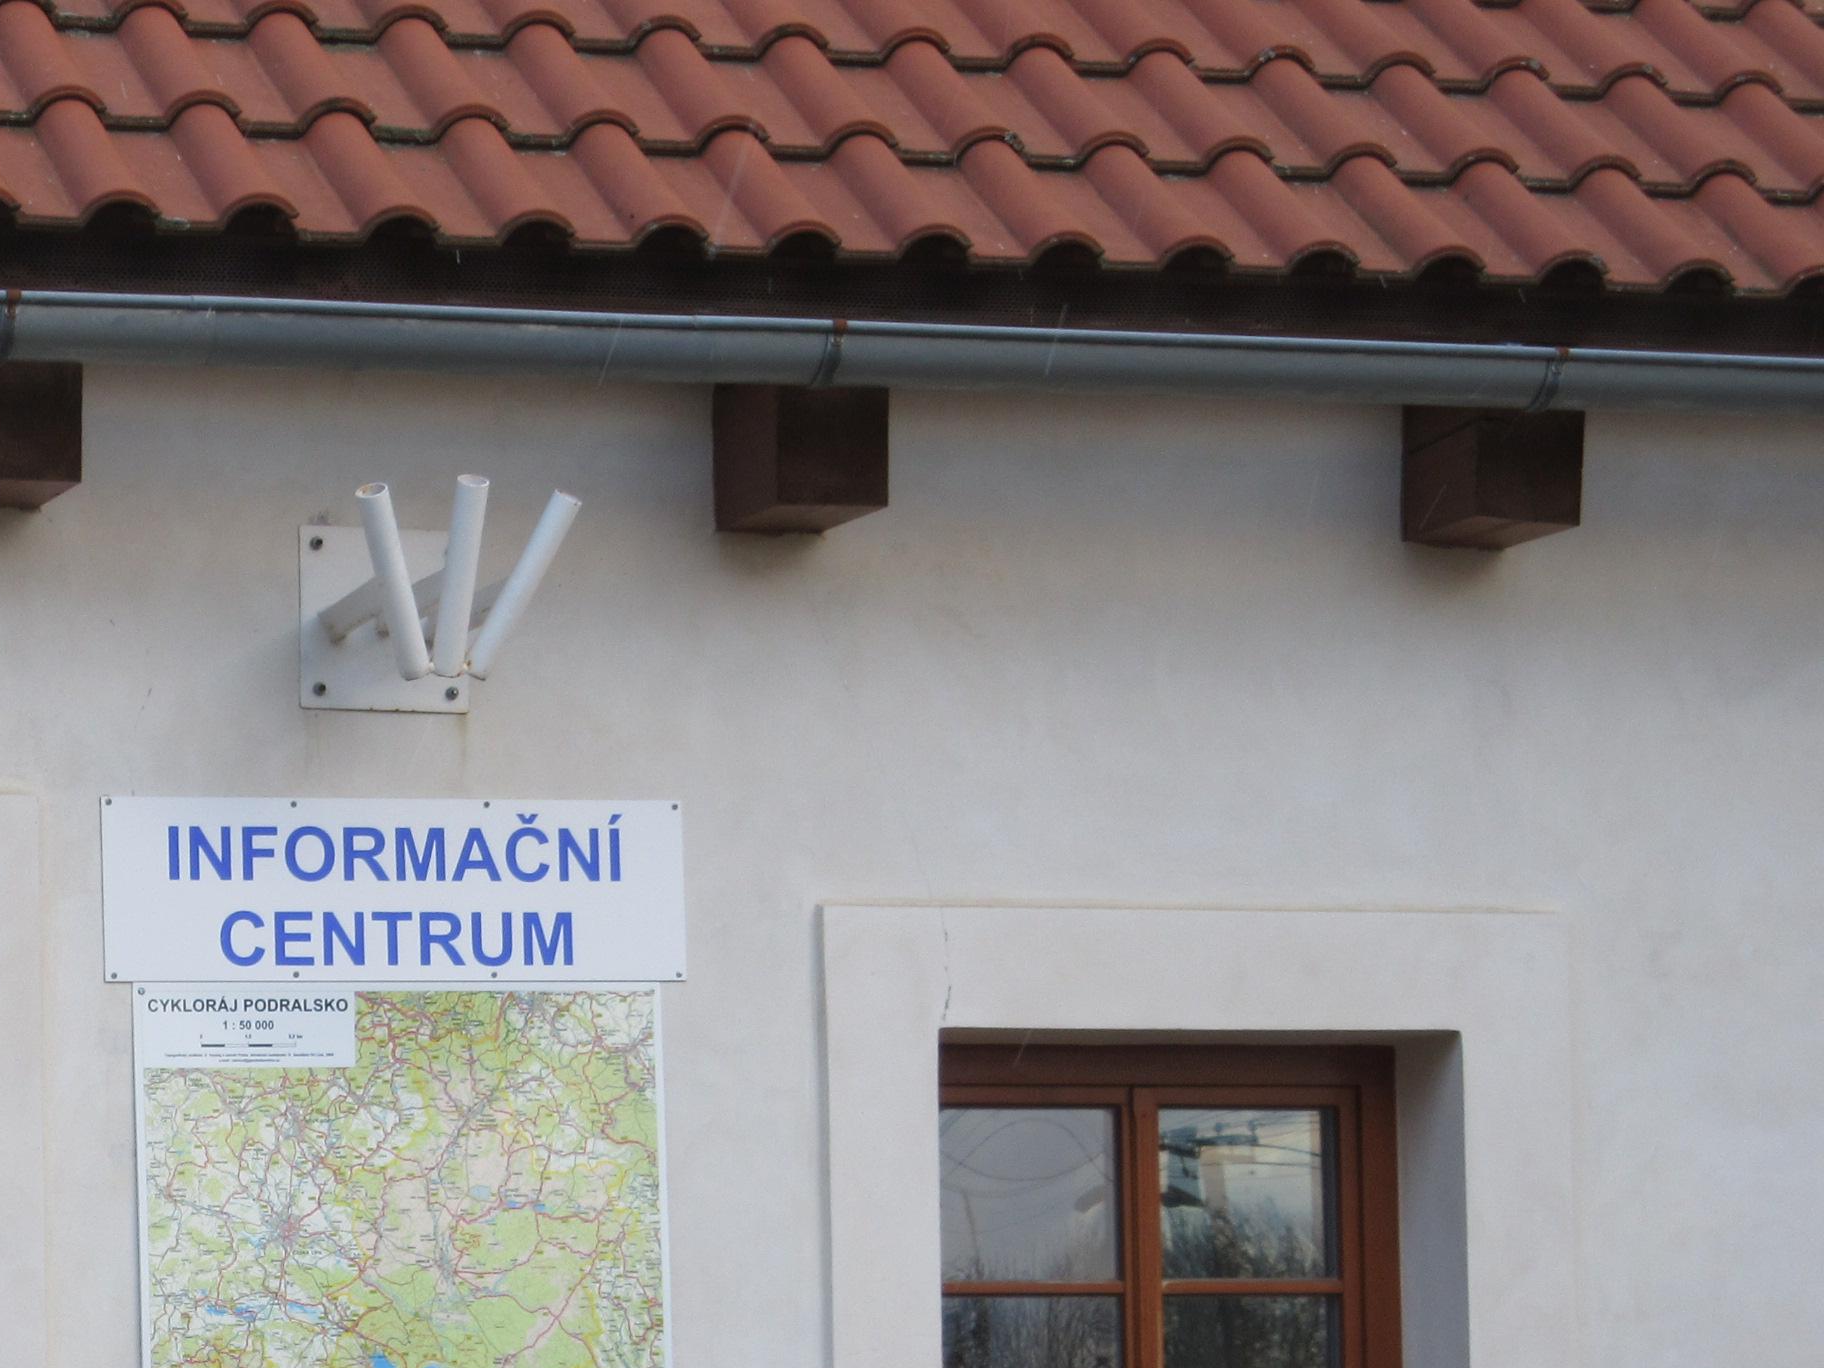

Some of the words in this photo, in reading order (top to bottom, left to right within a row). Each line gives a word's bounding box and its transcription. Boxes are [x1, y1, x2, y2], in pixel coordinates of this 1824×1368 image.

[166, 813, 623, 883] INFORMAČNÍ
[219, 910, 575, 967] CENTRUM
[147, 996, 238, 1013] CYKLORÁJ
[243, 998, 349, 1013] PODRALSKO
[239, 1020, 252, 1030] 50
[254, 1020, 275, 1030] 000
